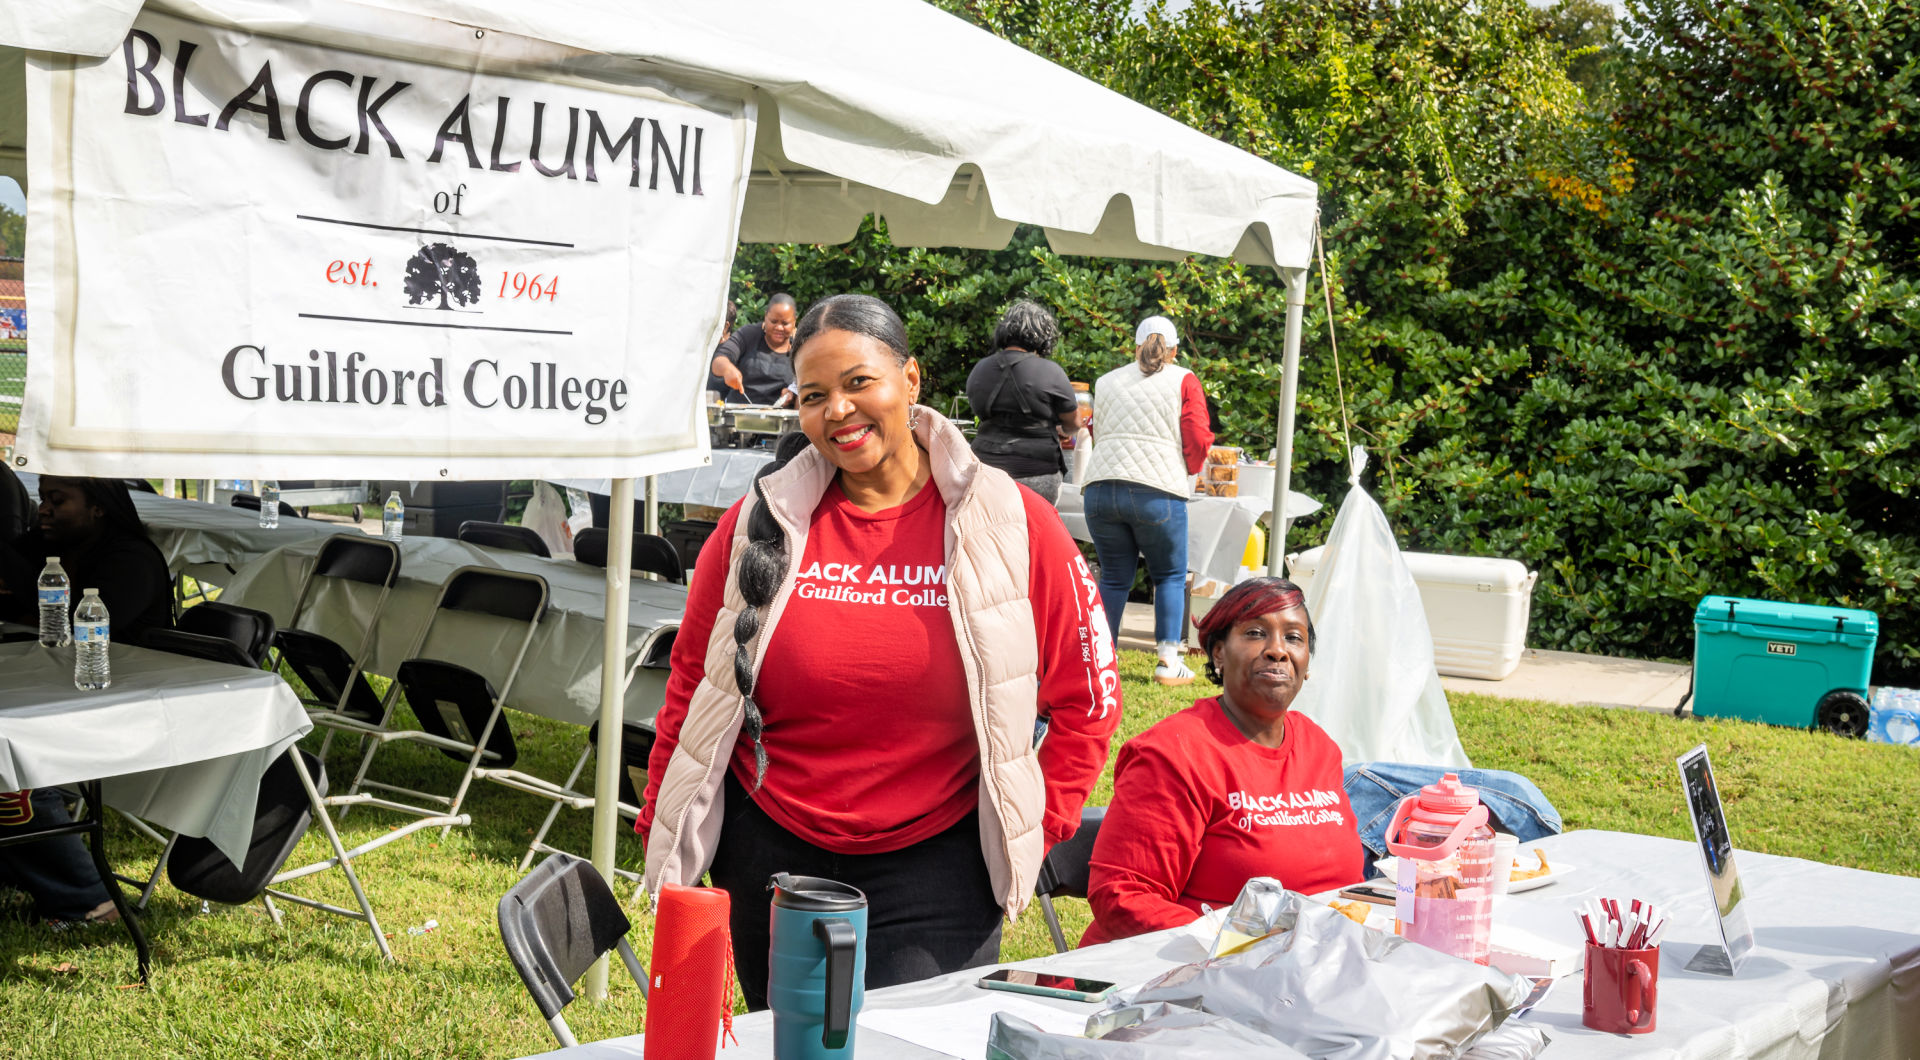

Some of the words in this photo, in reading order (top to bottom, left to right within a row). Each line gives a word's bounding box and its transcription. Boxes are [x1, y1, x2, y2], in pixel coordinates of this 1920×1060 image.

[123, 29, 411, 159] BLACK
[426, 93, 704, 196] ALUMNI
[433, 183, 467, 215] of
[325, 257, 379, 288] est.
[497, 271, 559, 302] 1964
[221, 344, 448, 408] Guilford
[463, 358, 628, 425] College
[866, 564, 946, 585] ALUM
[798, 582, 886, 605] Guilford
[891, 589, 951, 611] Colle
[1078, 626, 1088, 641] Est.
[1080, 641, 1091, 662] 1964
[1770, 643, 1794, 654] YETI
[1228, 789, 1290, 811] BLACK
[1239, 812, 1253, 832] of
[1253, 809, 1310, 826] Guilford
